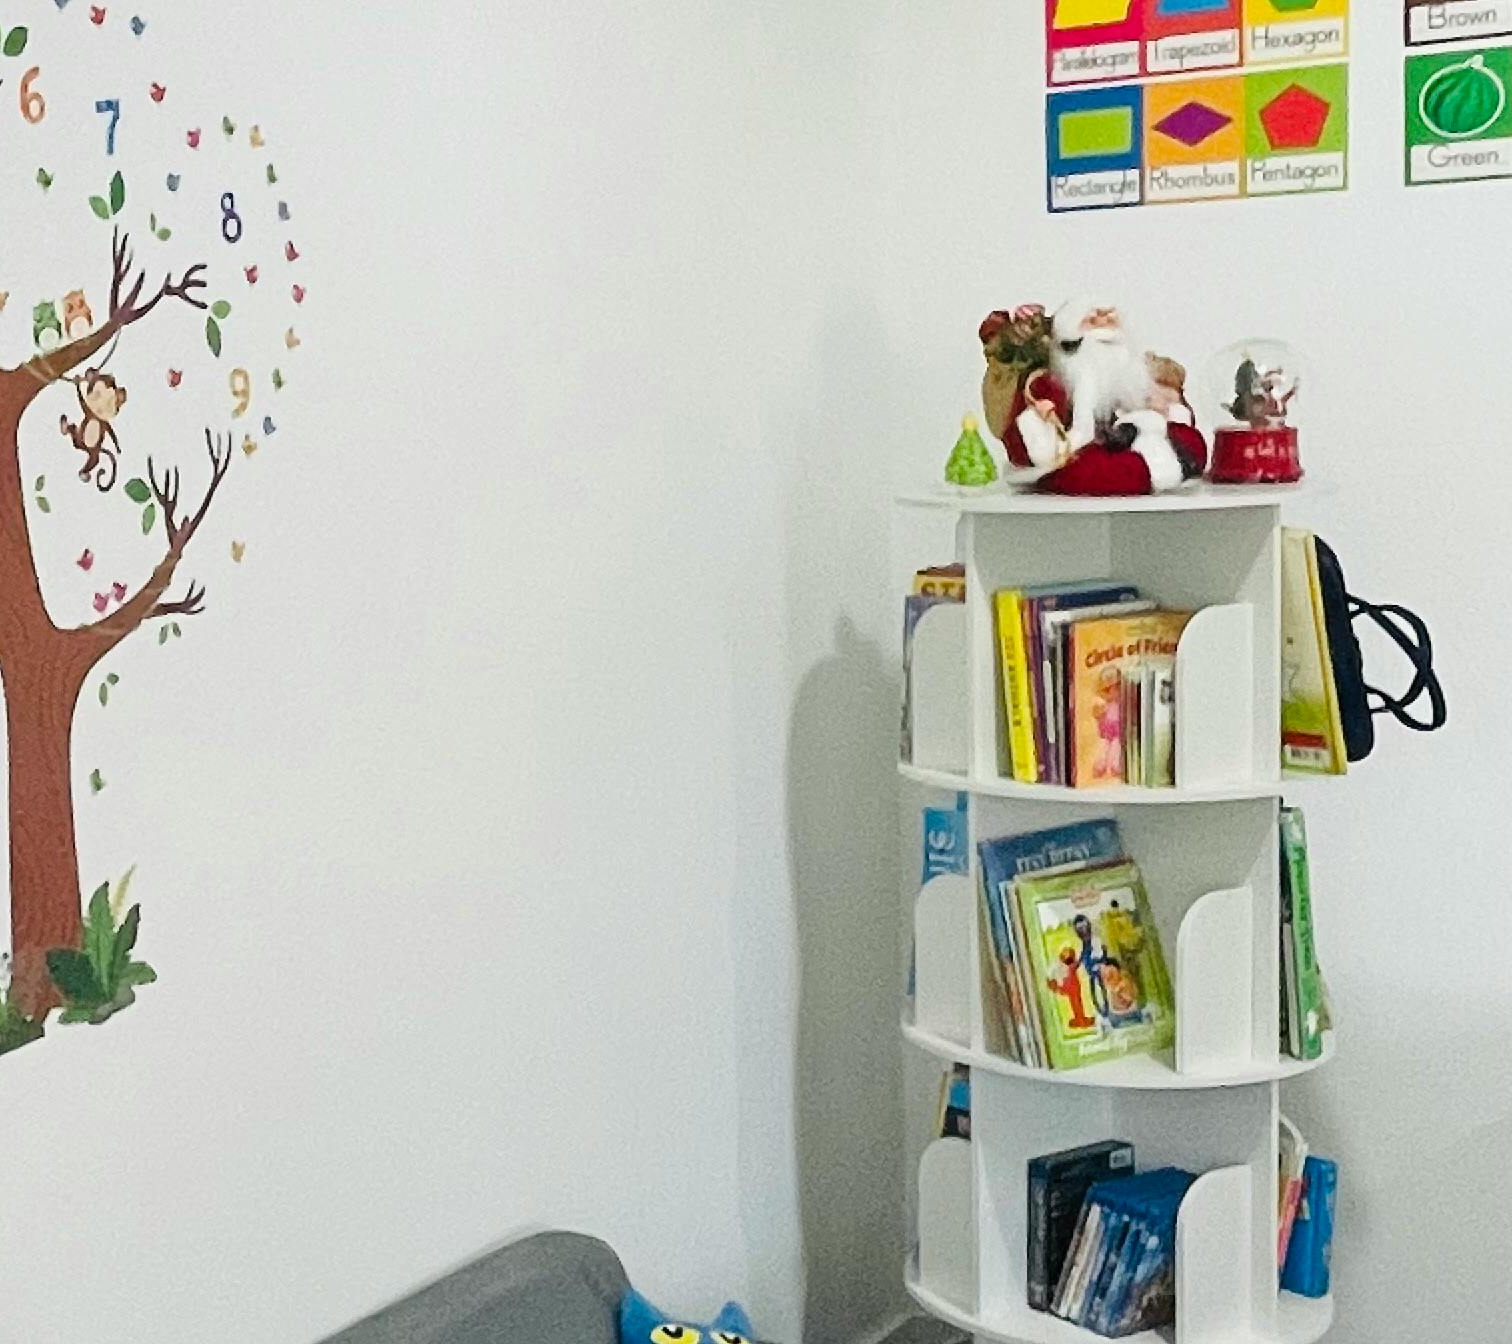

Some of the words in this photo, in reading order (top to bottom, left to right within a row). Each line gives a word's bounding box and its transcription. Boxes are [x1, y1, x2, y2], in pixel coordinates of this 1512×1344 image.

[1427, 5, 1497, 31] Brown
[1250, 24, 1340, 55] Hexagon
[19, 66, 47, 124] 6
[94, 98, 120, 155] 7
[1426, 146, 1500, 169] Green
[1149, 163, 1236, 192] Rhombus
[1249, 158, 1338, 189] Pentagon
[220, 191, 243, 244] 8
[229, 367, 251, 419] 9
